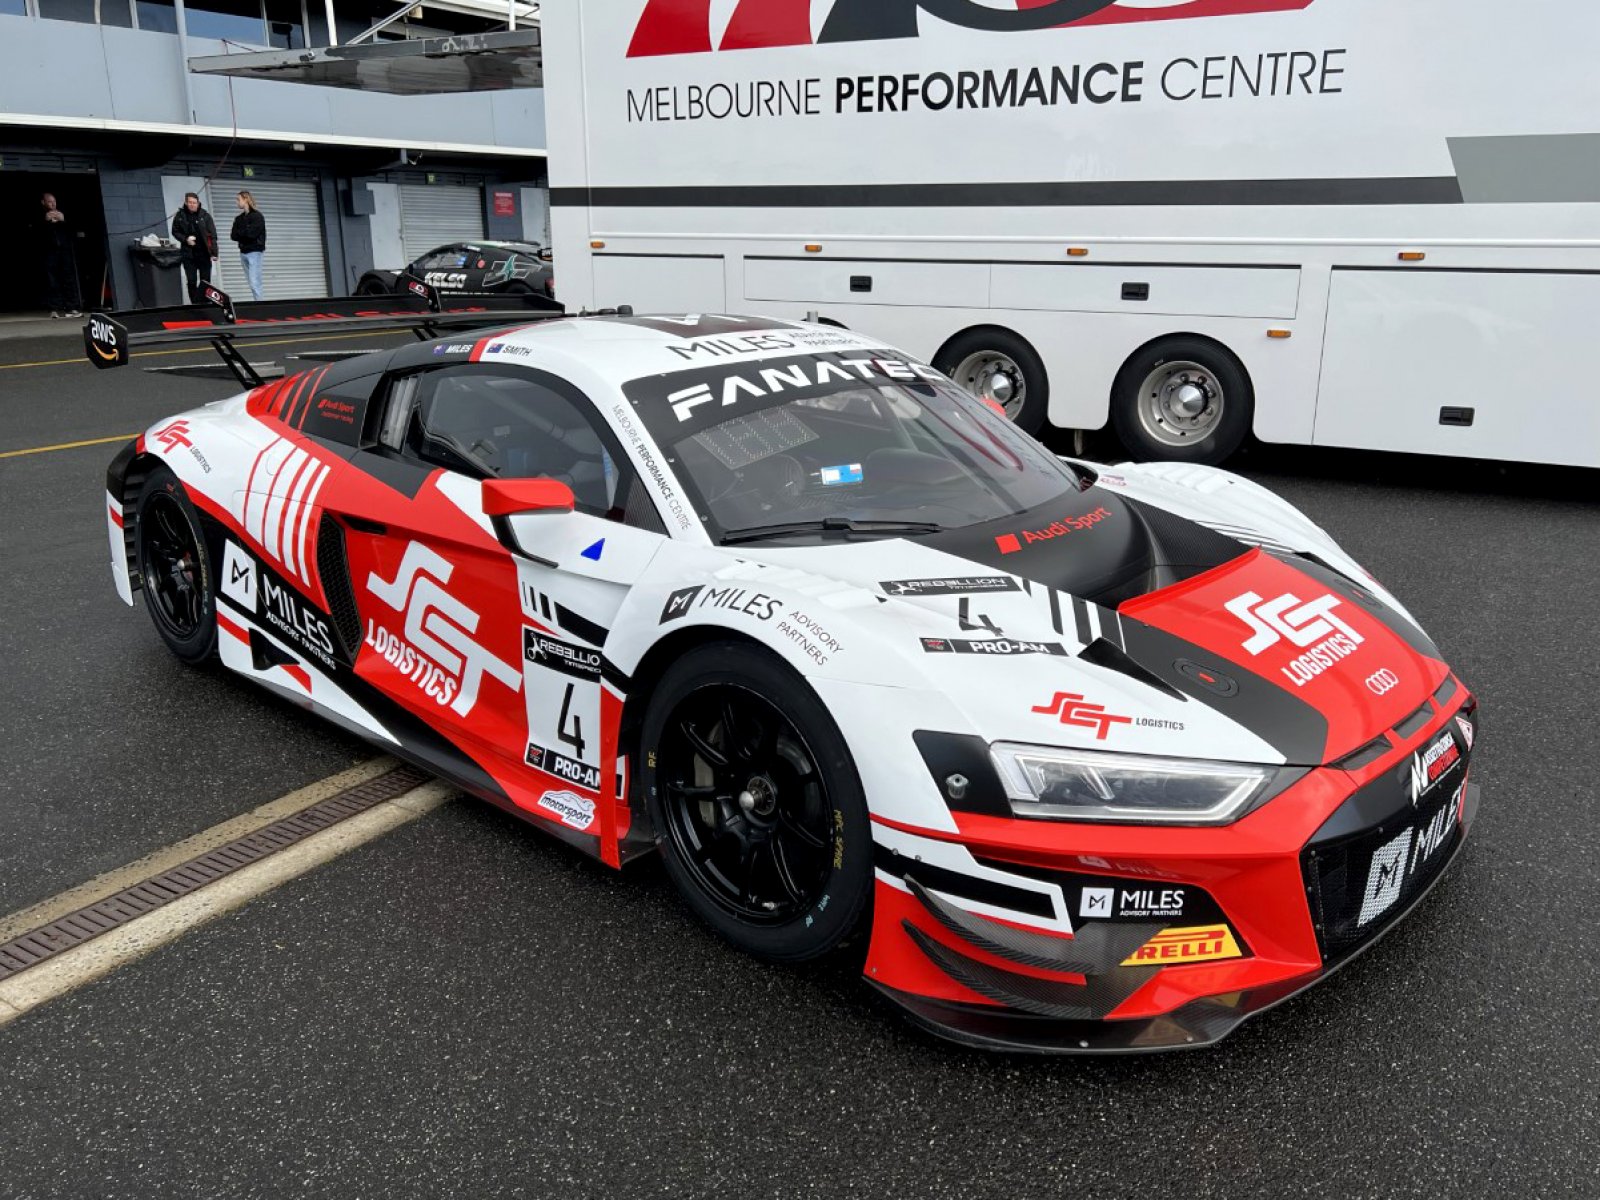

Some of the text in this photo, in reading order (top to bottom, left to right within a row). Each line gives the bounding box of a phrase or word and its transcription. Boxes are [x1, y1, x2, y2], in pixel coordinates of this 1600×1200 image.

[626, 48, 1347, 123] MELBOURNE PERFORMANCE CENTRE
[424, 271, 468, 289] KELSO
[90, 319, 117, 346] aws
[444, 344, 473, 354] MILES
[665, 335, 797, 361] MILES
[503, 345, 533, 357] SMITH
[666, 358, 944, 423] FANATEC
[613, 404, 692, 530] MELBOURNE PERFORMANCE CENTRE
[1021, 505, 1113, 544] Audi Sport
[262, 573, 334, 655] MILES
[699, 587, 783, 621] MILES
[958, 596, 1004, 637] 4
[776, 621, 828, 666] PARTNERS
[788, 610, 844, 655] ADVISORY
[968, 641, 1050, 654] PRO-AM
[365, 618, 457, 708] LOGISTICS
[540, 638, 600, 667] REBELLIO
[1280, 633, 1358, 688] LOGISTICS
[557, 682, 586, 760] 4
[1135, 716, 1186, 732] LOGISTICS
[540, 795, 592, 824] motorsport
[1119, 889, 1185, 909] MILES
